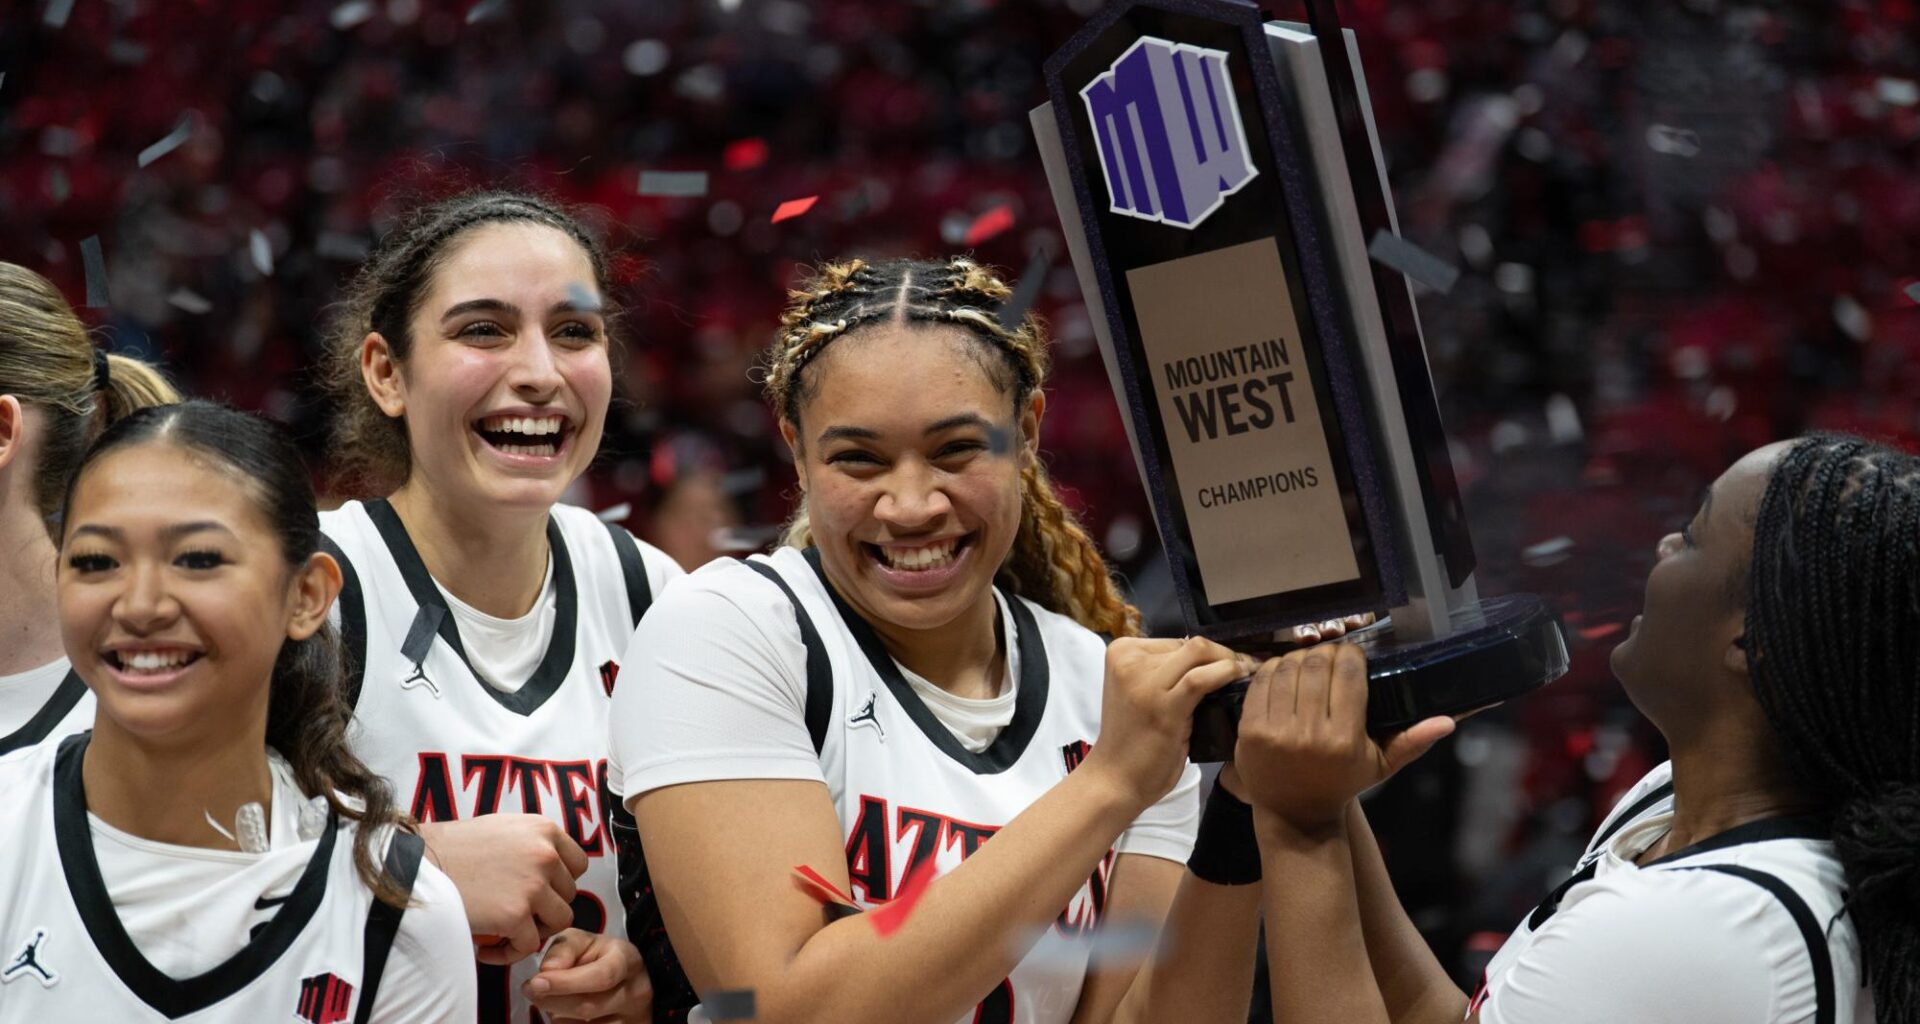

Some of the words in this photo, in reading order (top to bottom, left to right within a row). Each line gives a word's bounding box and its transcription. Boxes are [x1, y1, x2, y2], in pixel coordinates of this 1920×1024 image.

[1080, 36, 1259, 229] MW
[1164, 338, 1290, 390] MOUNTAIN
[1173, 371, 1295, 444] WEST
[1198, 467, 1319, 508] CHAMPIONS
